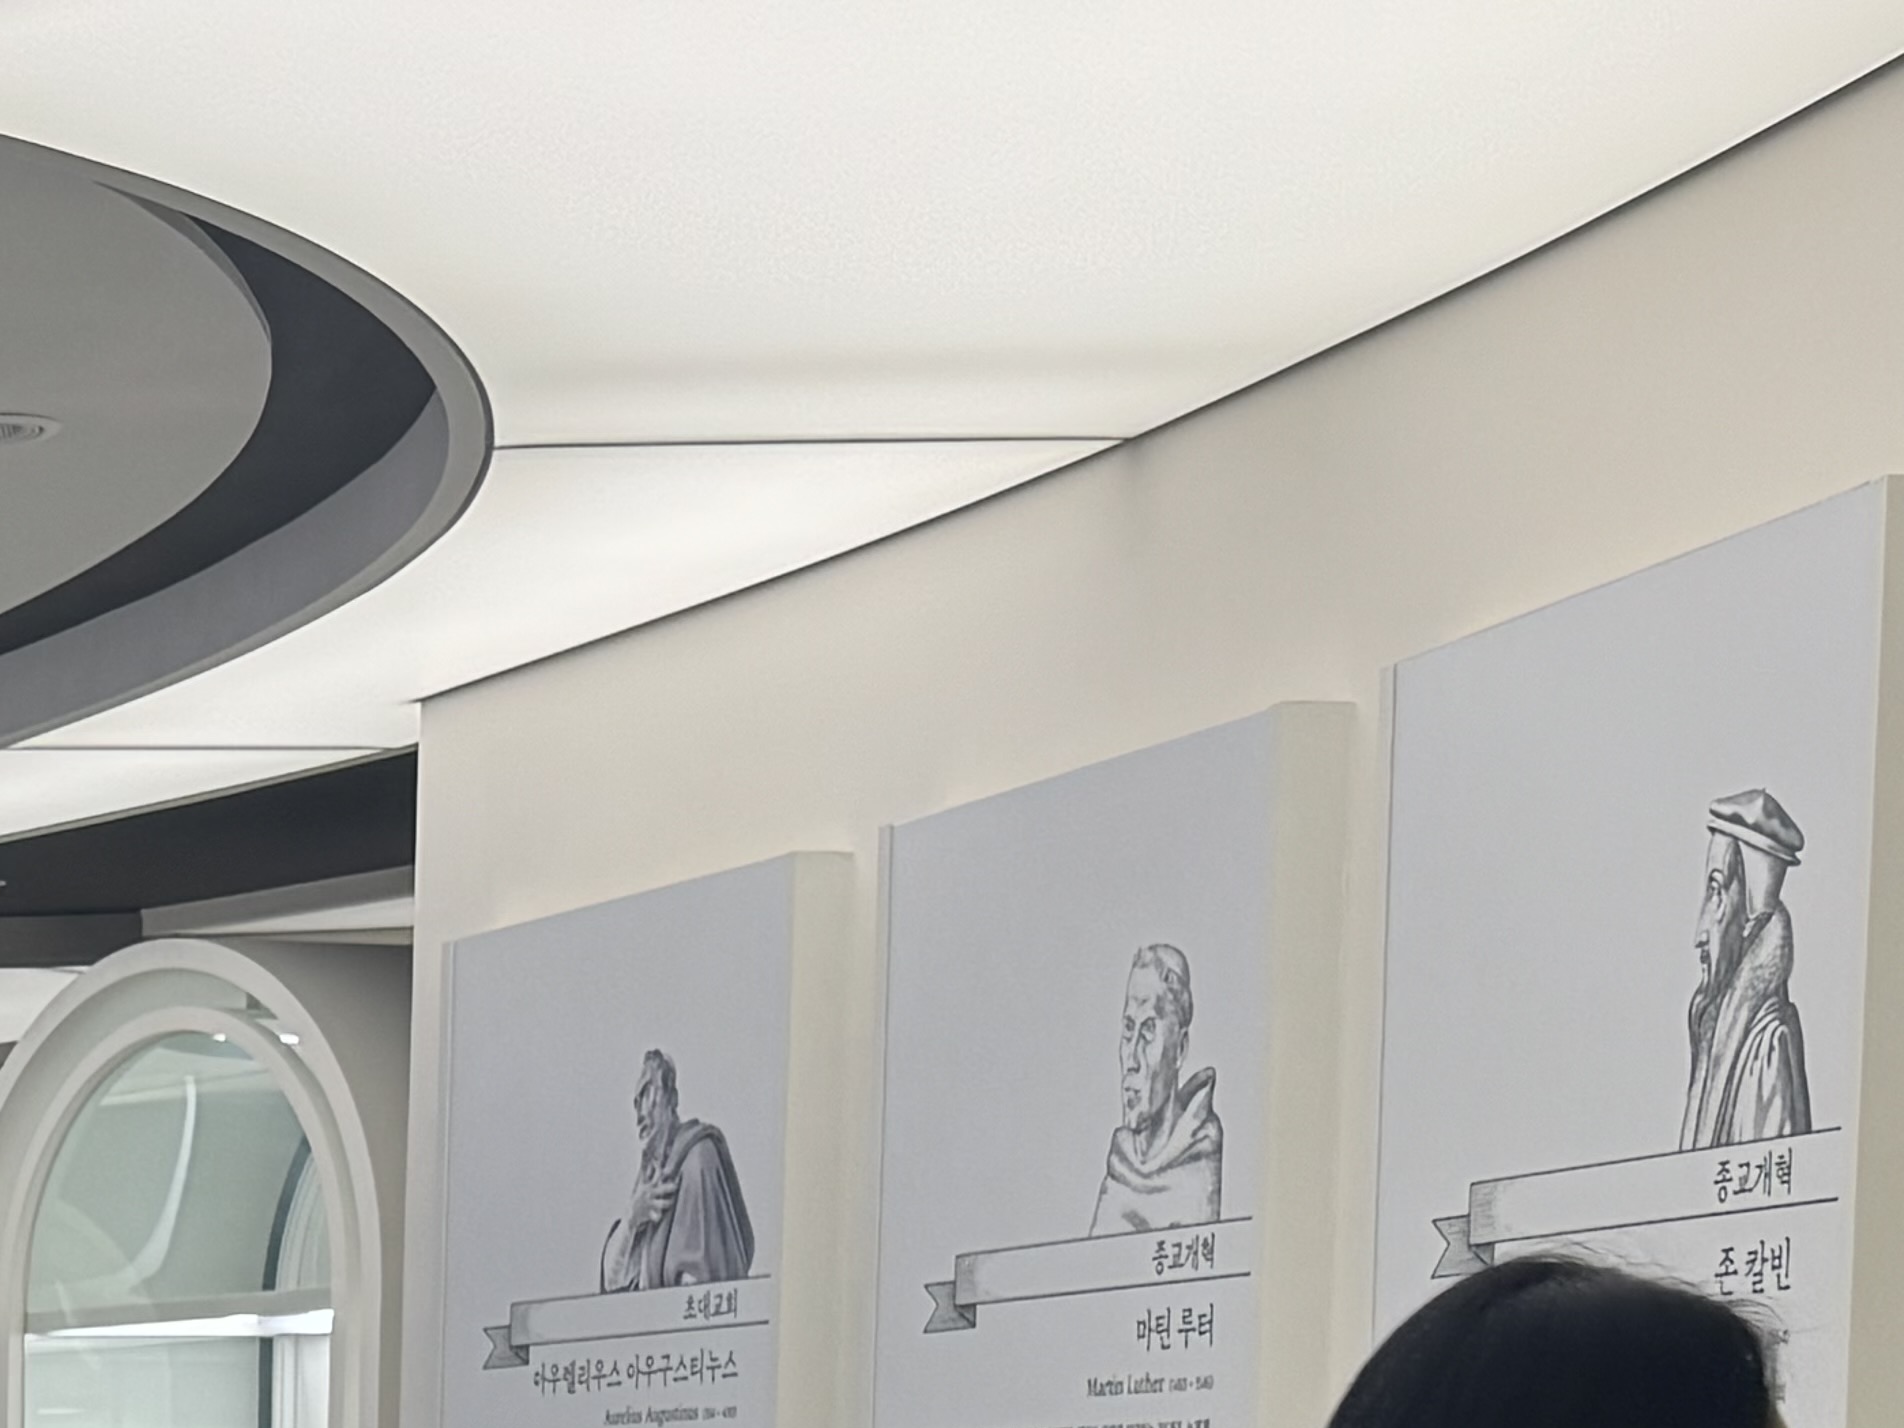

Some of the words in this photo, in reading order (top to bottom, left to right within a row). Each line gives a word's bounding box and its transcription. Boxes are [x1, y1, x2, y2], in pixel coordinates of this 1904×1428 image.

[1713, 1147, 1792, 1203] 종교개혁
[1152, 1232, 1215, 1275] 종교개혁
[1714, 1246, 1738, 1296] 존
[1744, 1236, 1791, 1294] 칼빈
[683, 1288, 738, 1320] 초대교회
[1136, 1306, 1171, 1351] 마틴
[1177, 1303, 1214, 1349] 루터
[533, 1357, 622, 1395] 아우렐리우스
[626, 1348, 739, 1390] 아우구스티누스
[1127, 1371, 1164, 1395] Luther
